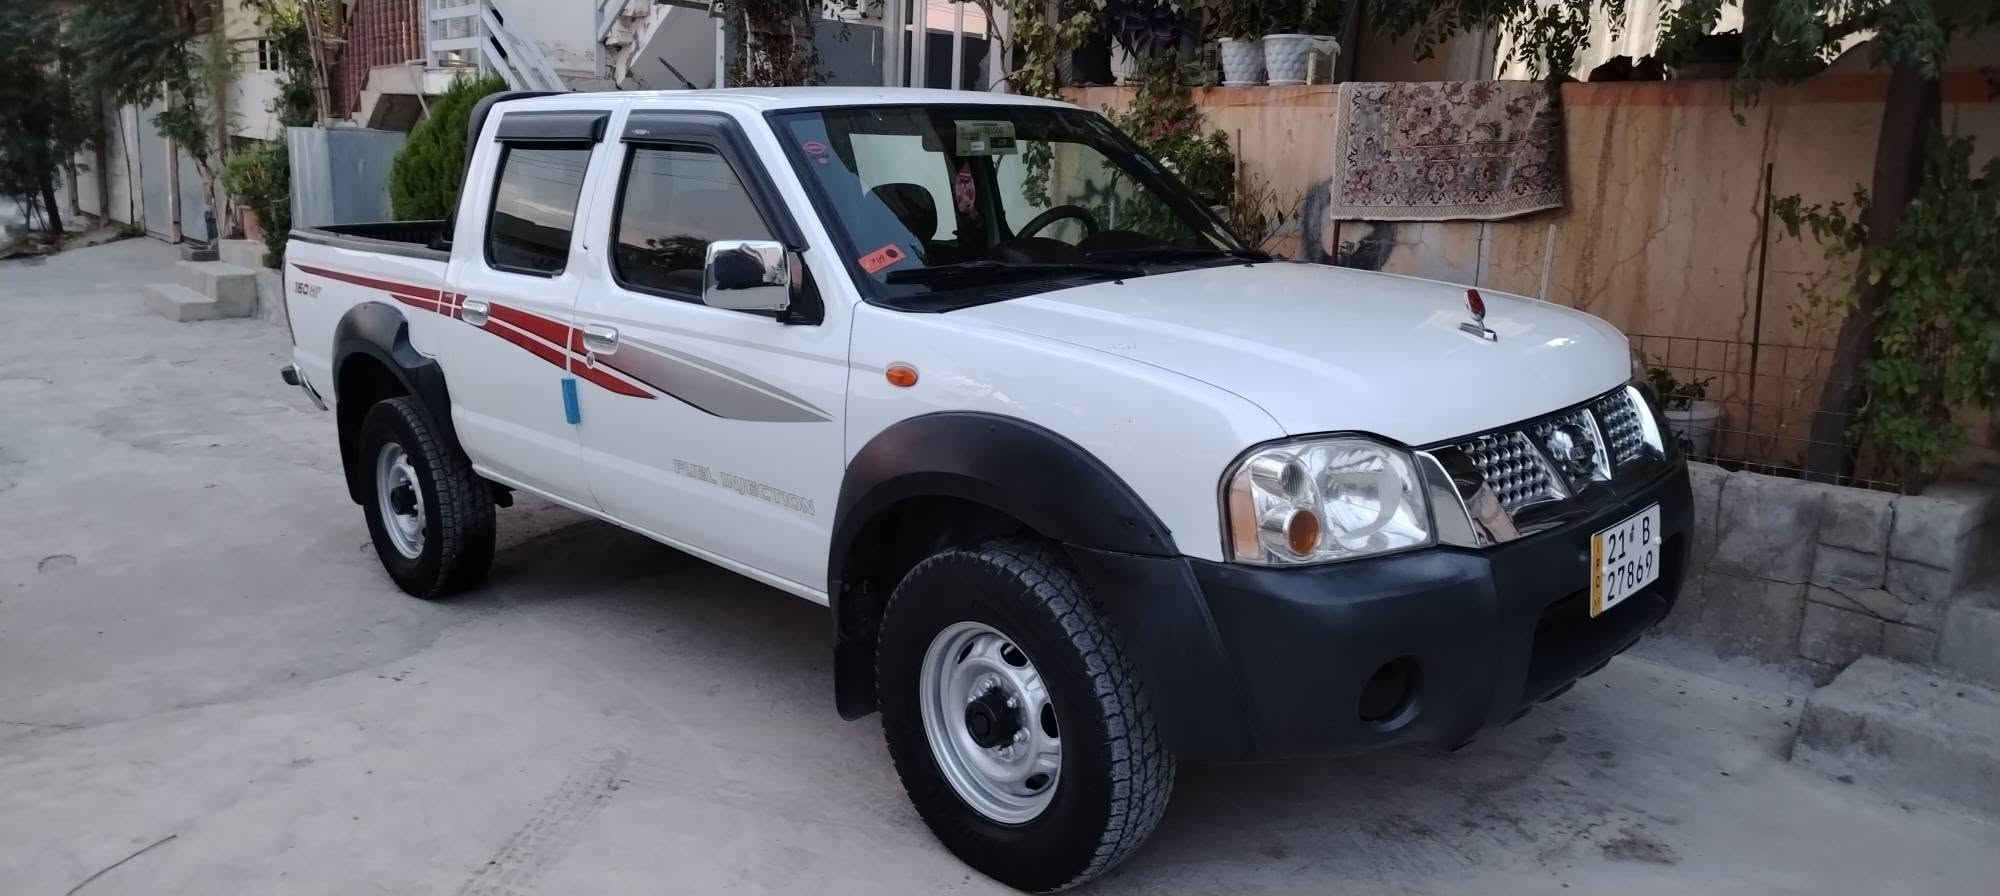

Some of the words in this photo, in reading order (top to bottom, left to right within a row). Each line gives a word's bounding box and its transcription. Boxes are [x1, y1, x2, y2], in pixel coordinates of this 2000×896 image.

[672, 458, 718, 485] FUEL
[719, 471, 817, 516] INJECTION
[1607, 529, 1625, 565] 21
[1642, 516, 1650, 545] B
[1607, 550, 1653, 602] 27869
